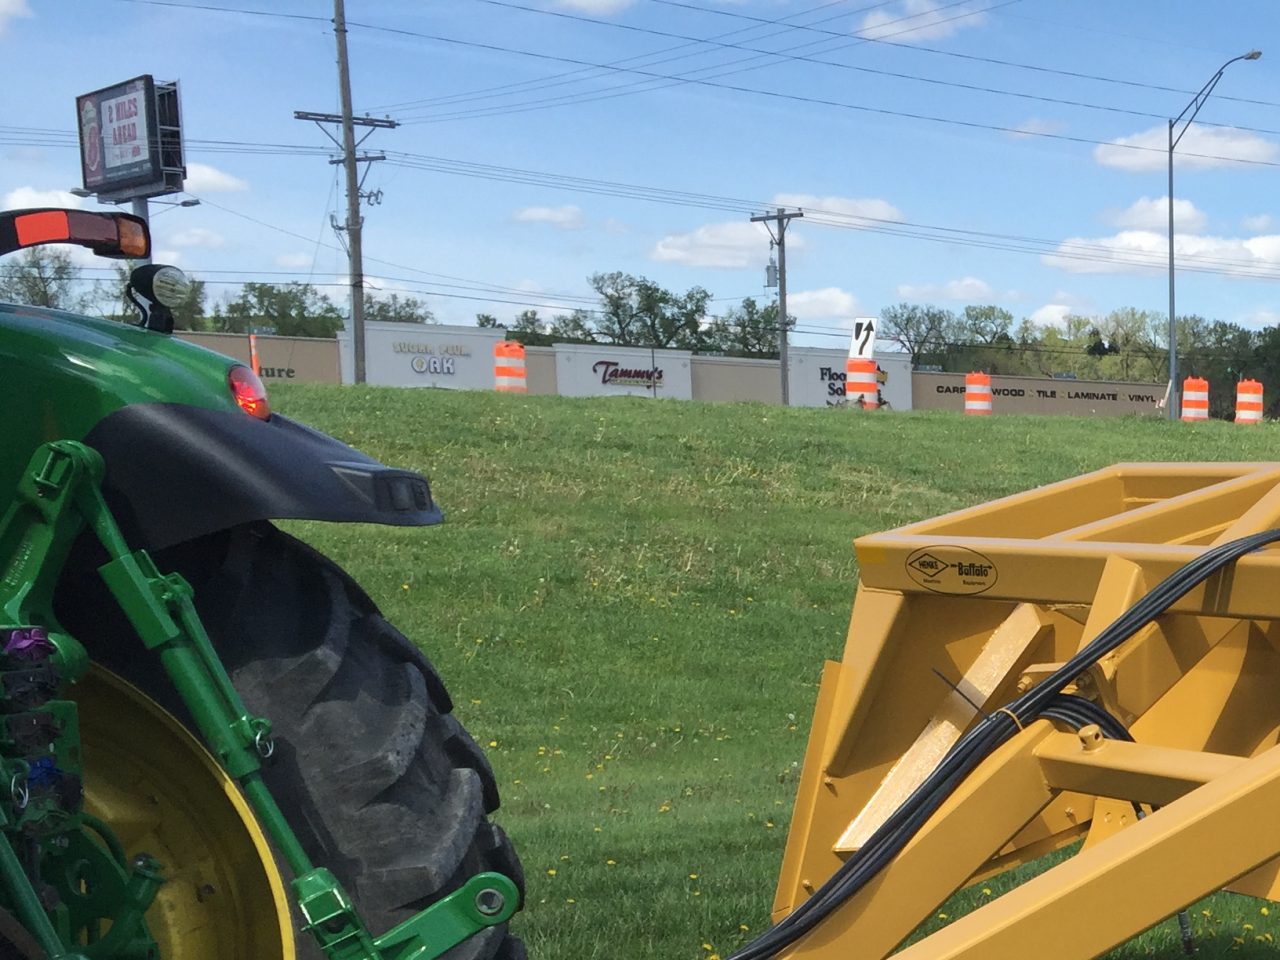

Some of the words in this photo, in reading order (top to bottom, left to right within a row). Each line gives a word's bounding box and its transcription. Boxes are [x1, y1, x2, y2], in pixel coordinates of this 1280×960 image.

[112, 122, 137, 146] AHEAD
[258, 366, 295, 378] ture
[411, 357, 455, 374] OAK
[593, 360, 663, 389] Tammy's
[820, 367, 847, 381] Floo
[828, 382, 847, 396] Sol
[936, 386, 967, 394] CARP
[991, 388, 1025, 397] WOOD
[1036, 390, 1057, 398] TILE
[1067, 391, 1118, 401] LAMINATE
[1128, 394, 1157, 403] VINYL
[958, 562, 989, 577] Buffalo
